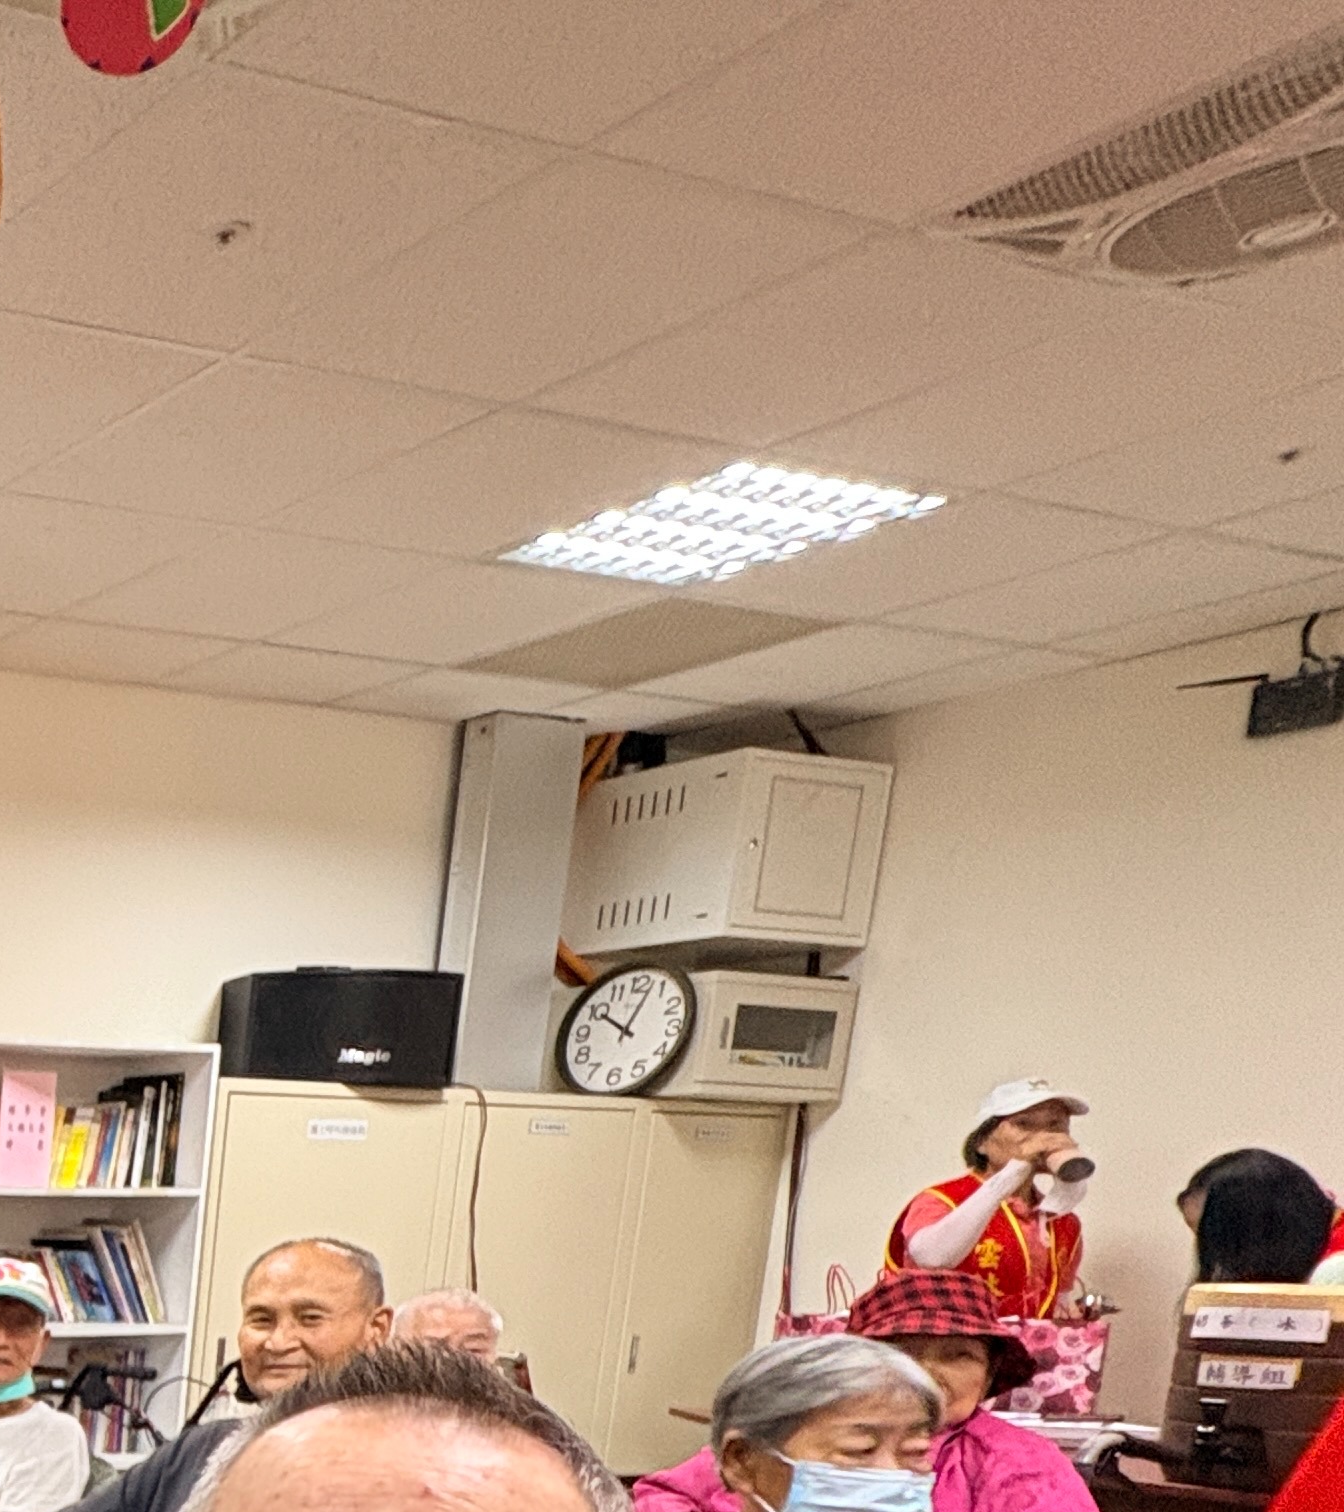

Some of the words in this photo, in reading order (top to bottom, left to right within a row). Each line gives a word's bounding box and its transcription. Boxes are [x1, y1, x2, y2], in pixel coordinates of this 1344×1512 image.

[610, 984, 625, 1003] 11
[631, 974, 651, 994] 12
[658, 980, 666, 998] 1
[588, 1003, 610, 1021] 10
[664, 996, 682, 1016] 2
[575, 1024, 591, 1044] 9
[665, 1018, 682, 1037] 3
[574, 1045, 591, 1064] 8
[653, 1041, 668, 1059] 4
[587, 1061, 602, 1083] 7
[606, 1067, 622, 1086] 6
[630, 1059, 648, 1079] 5
